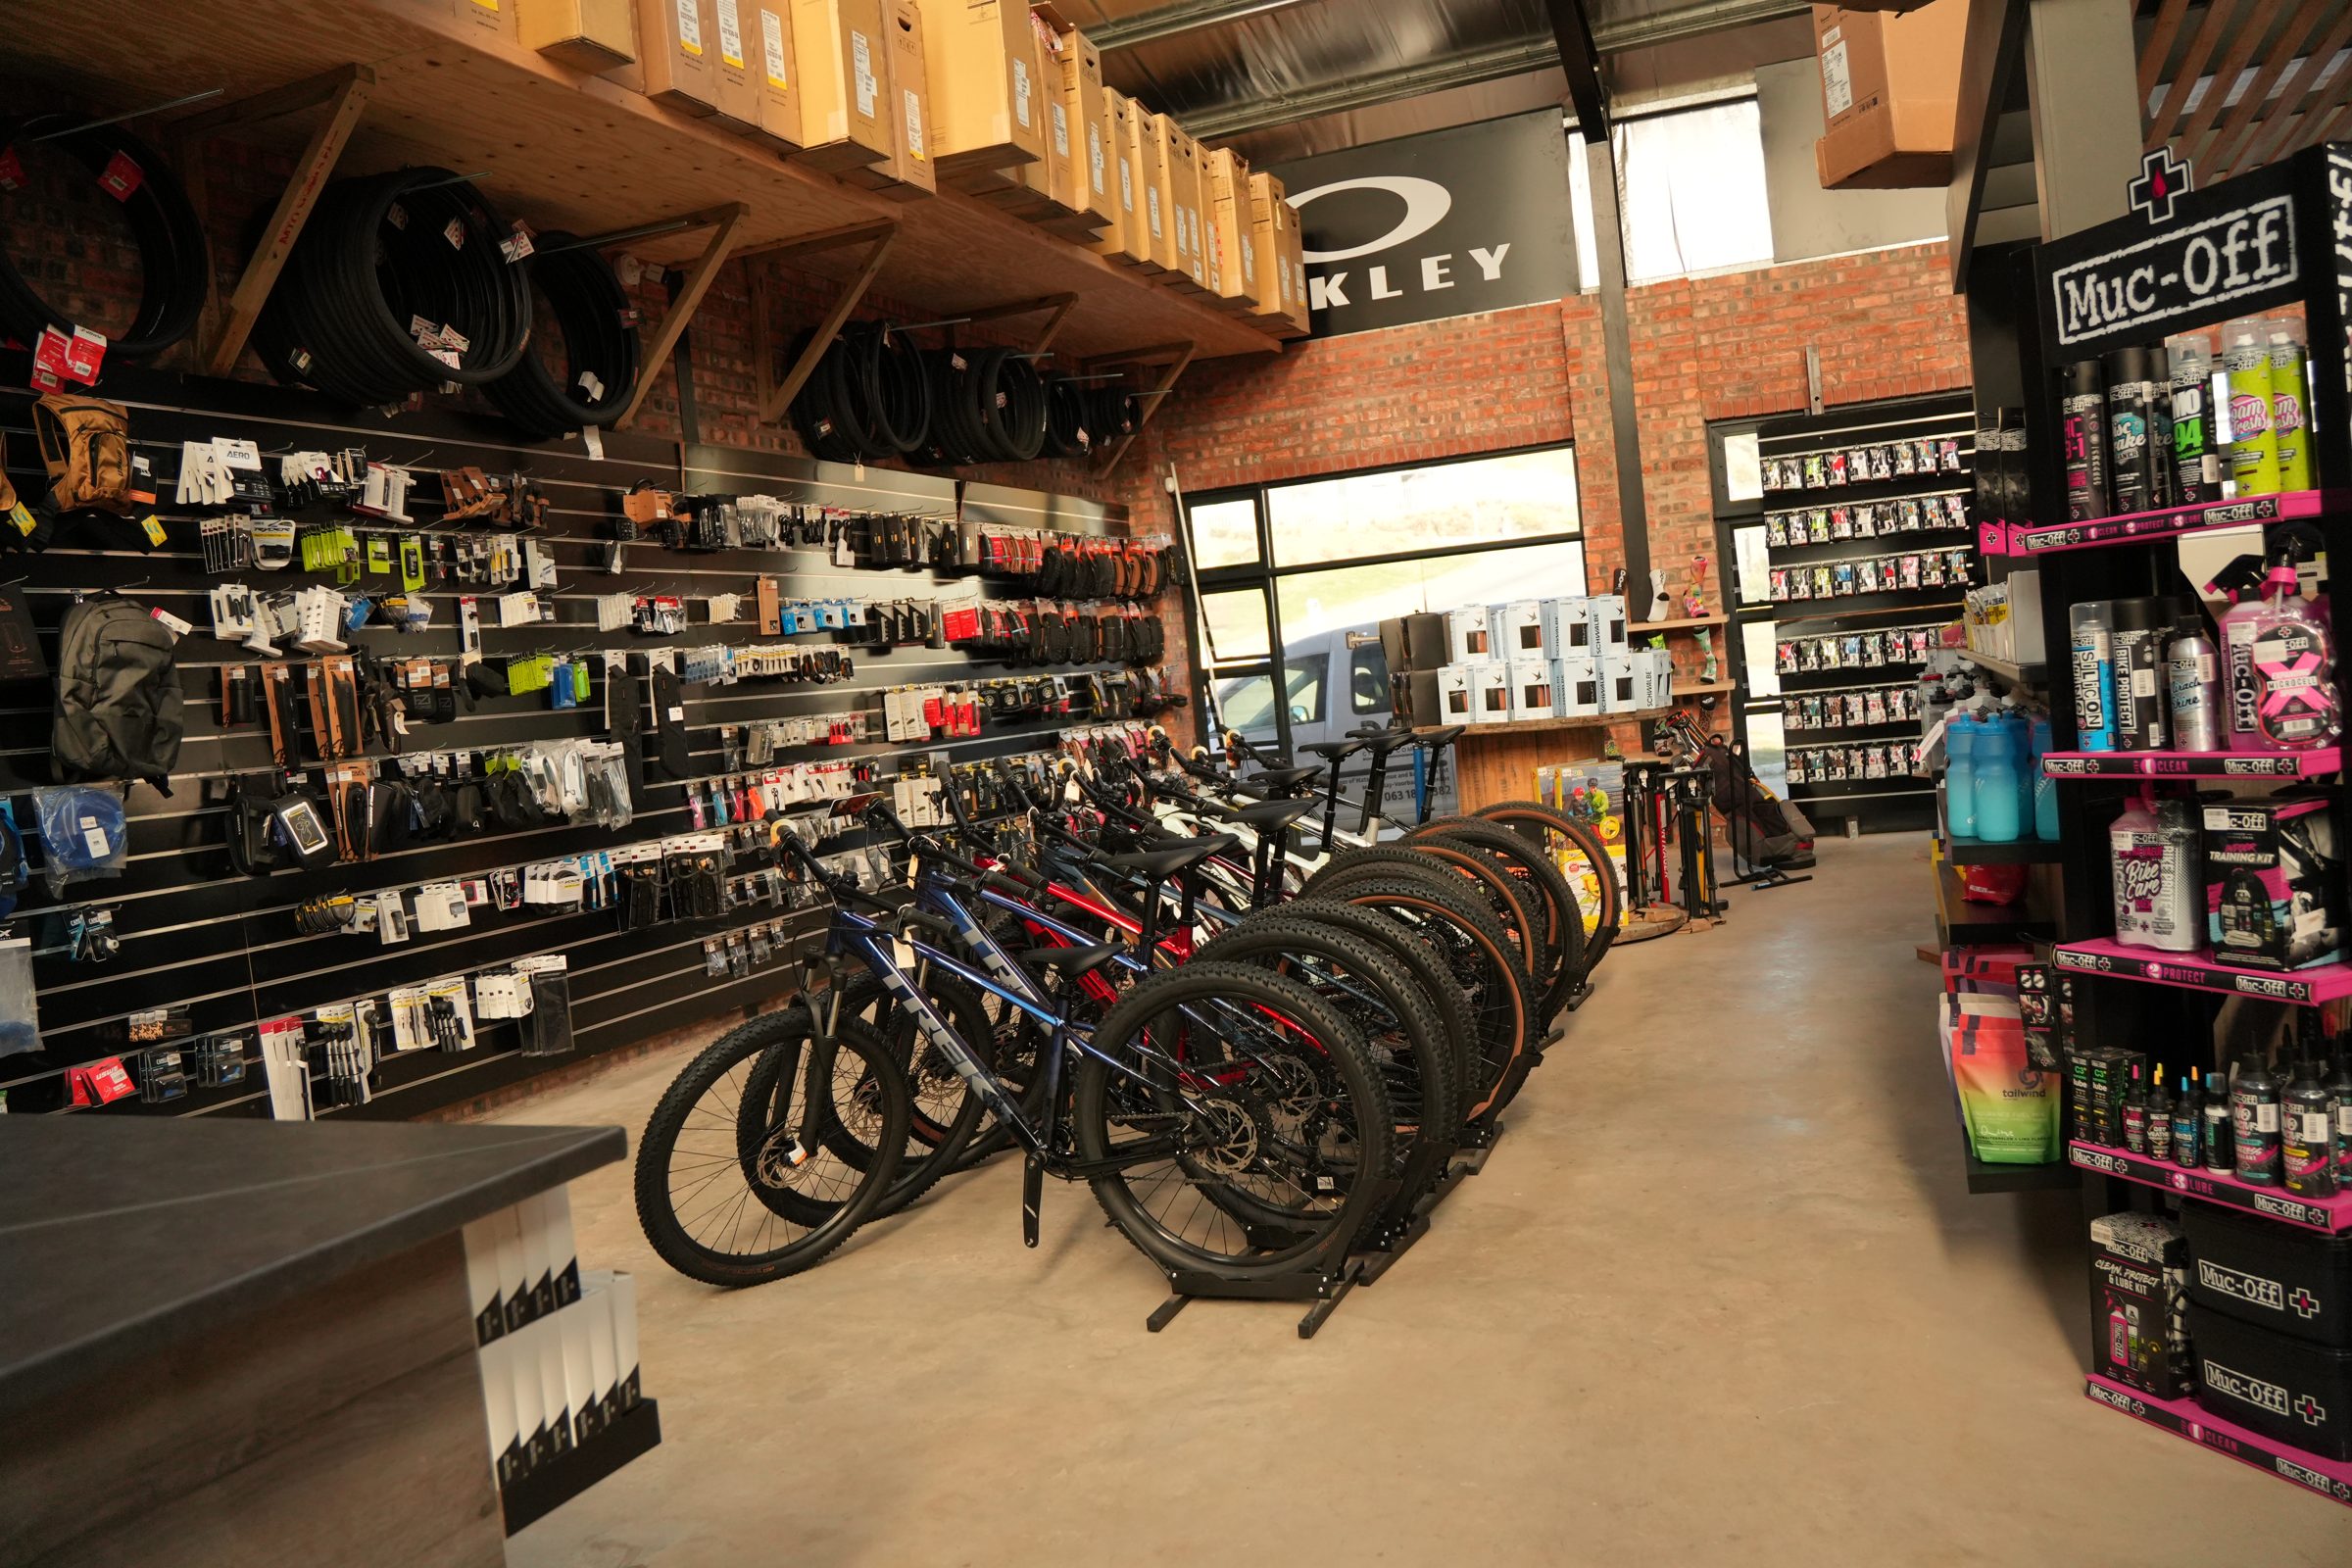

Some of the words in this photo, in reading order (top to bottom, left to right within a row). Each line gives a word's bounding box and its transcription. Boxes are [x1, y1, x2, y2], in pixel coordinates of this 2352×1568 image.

[1309, 243, 1510, 311] KLEY
[2064, 209, 2282, 331] Muc-Off
[2230, 398, 2263, 420] oam
[2274, 396, 2296, 413] am
[2113, 420, 2132, 439] isc
[2276, 411, 2295, 427] esh
[2115, 432, 2146, 451] ake
[2175, 418, 2203, 452] 94
[227, 451, 250, 460] AERO
[2029, 533, 2064, 549] Muc-Off
[2208, 505, 2252, 523] Muc-Off
[1593, 613, 1602, 655] SCHWALBE
[2116, 649, 2130, 676] BIKE
[1598, 671, 1607, 711] SCHWALBE
[2269, 677, 2317, 691] MICROCELL
[2118, 677, 2133, 727] PROTECT
[2046, 760, 2083, 772] Muc-Off
[2157, 760, 2187, 772] CLEAN
[2228, 760, 2273, 773] Muc-Off
[1385, 790, 1403, 801] 063
[2229, 814, 2264, 829] c-Off
[2210, 851, 2256, 862] TRAINING
[2258, 854, 2275, 863] KIT
[2126, 860, 2159, 882] Bike
[2059, 954, 2095, 969] Muc-Off
[2163, 967, 2205, 984] PROTECT
[2237, 977, 2284, 996] Muc-Off
[881, 968, 998, 1102] TREK
[2074, 1079, 2087, 1089] lube
[2094, 1069, 2105, 1078] C3
[2002, 1089, 2046, 1098] tailwind
[2092, 1082, 2107, 1092] lube
[2074, 1150, 2112, 1168] Muc-Off
[2189, 1179, 2215, 1195] LUBE
[2256, 1196, 2304, 1219] Muc-Off
[2116, 1277, 2133, 1291] LUBE
[2135, 1283, 2147, 1296] KIT
[2125, 1268, 2162, 1288] PROTECT
[2202, 1264, 2278, 1305] Muc-Off
[2208, 1365, 2284, 1411] Muc-Off
[2091, 1384, 2130, 1410] Muc-Off
[2205, 1430, 2238, 1452] CLEAN
[2278, 1459, 2328, 1492] Muc-Off
